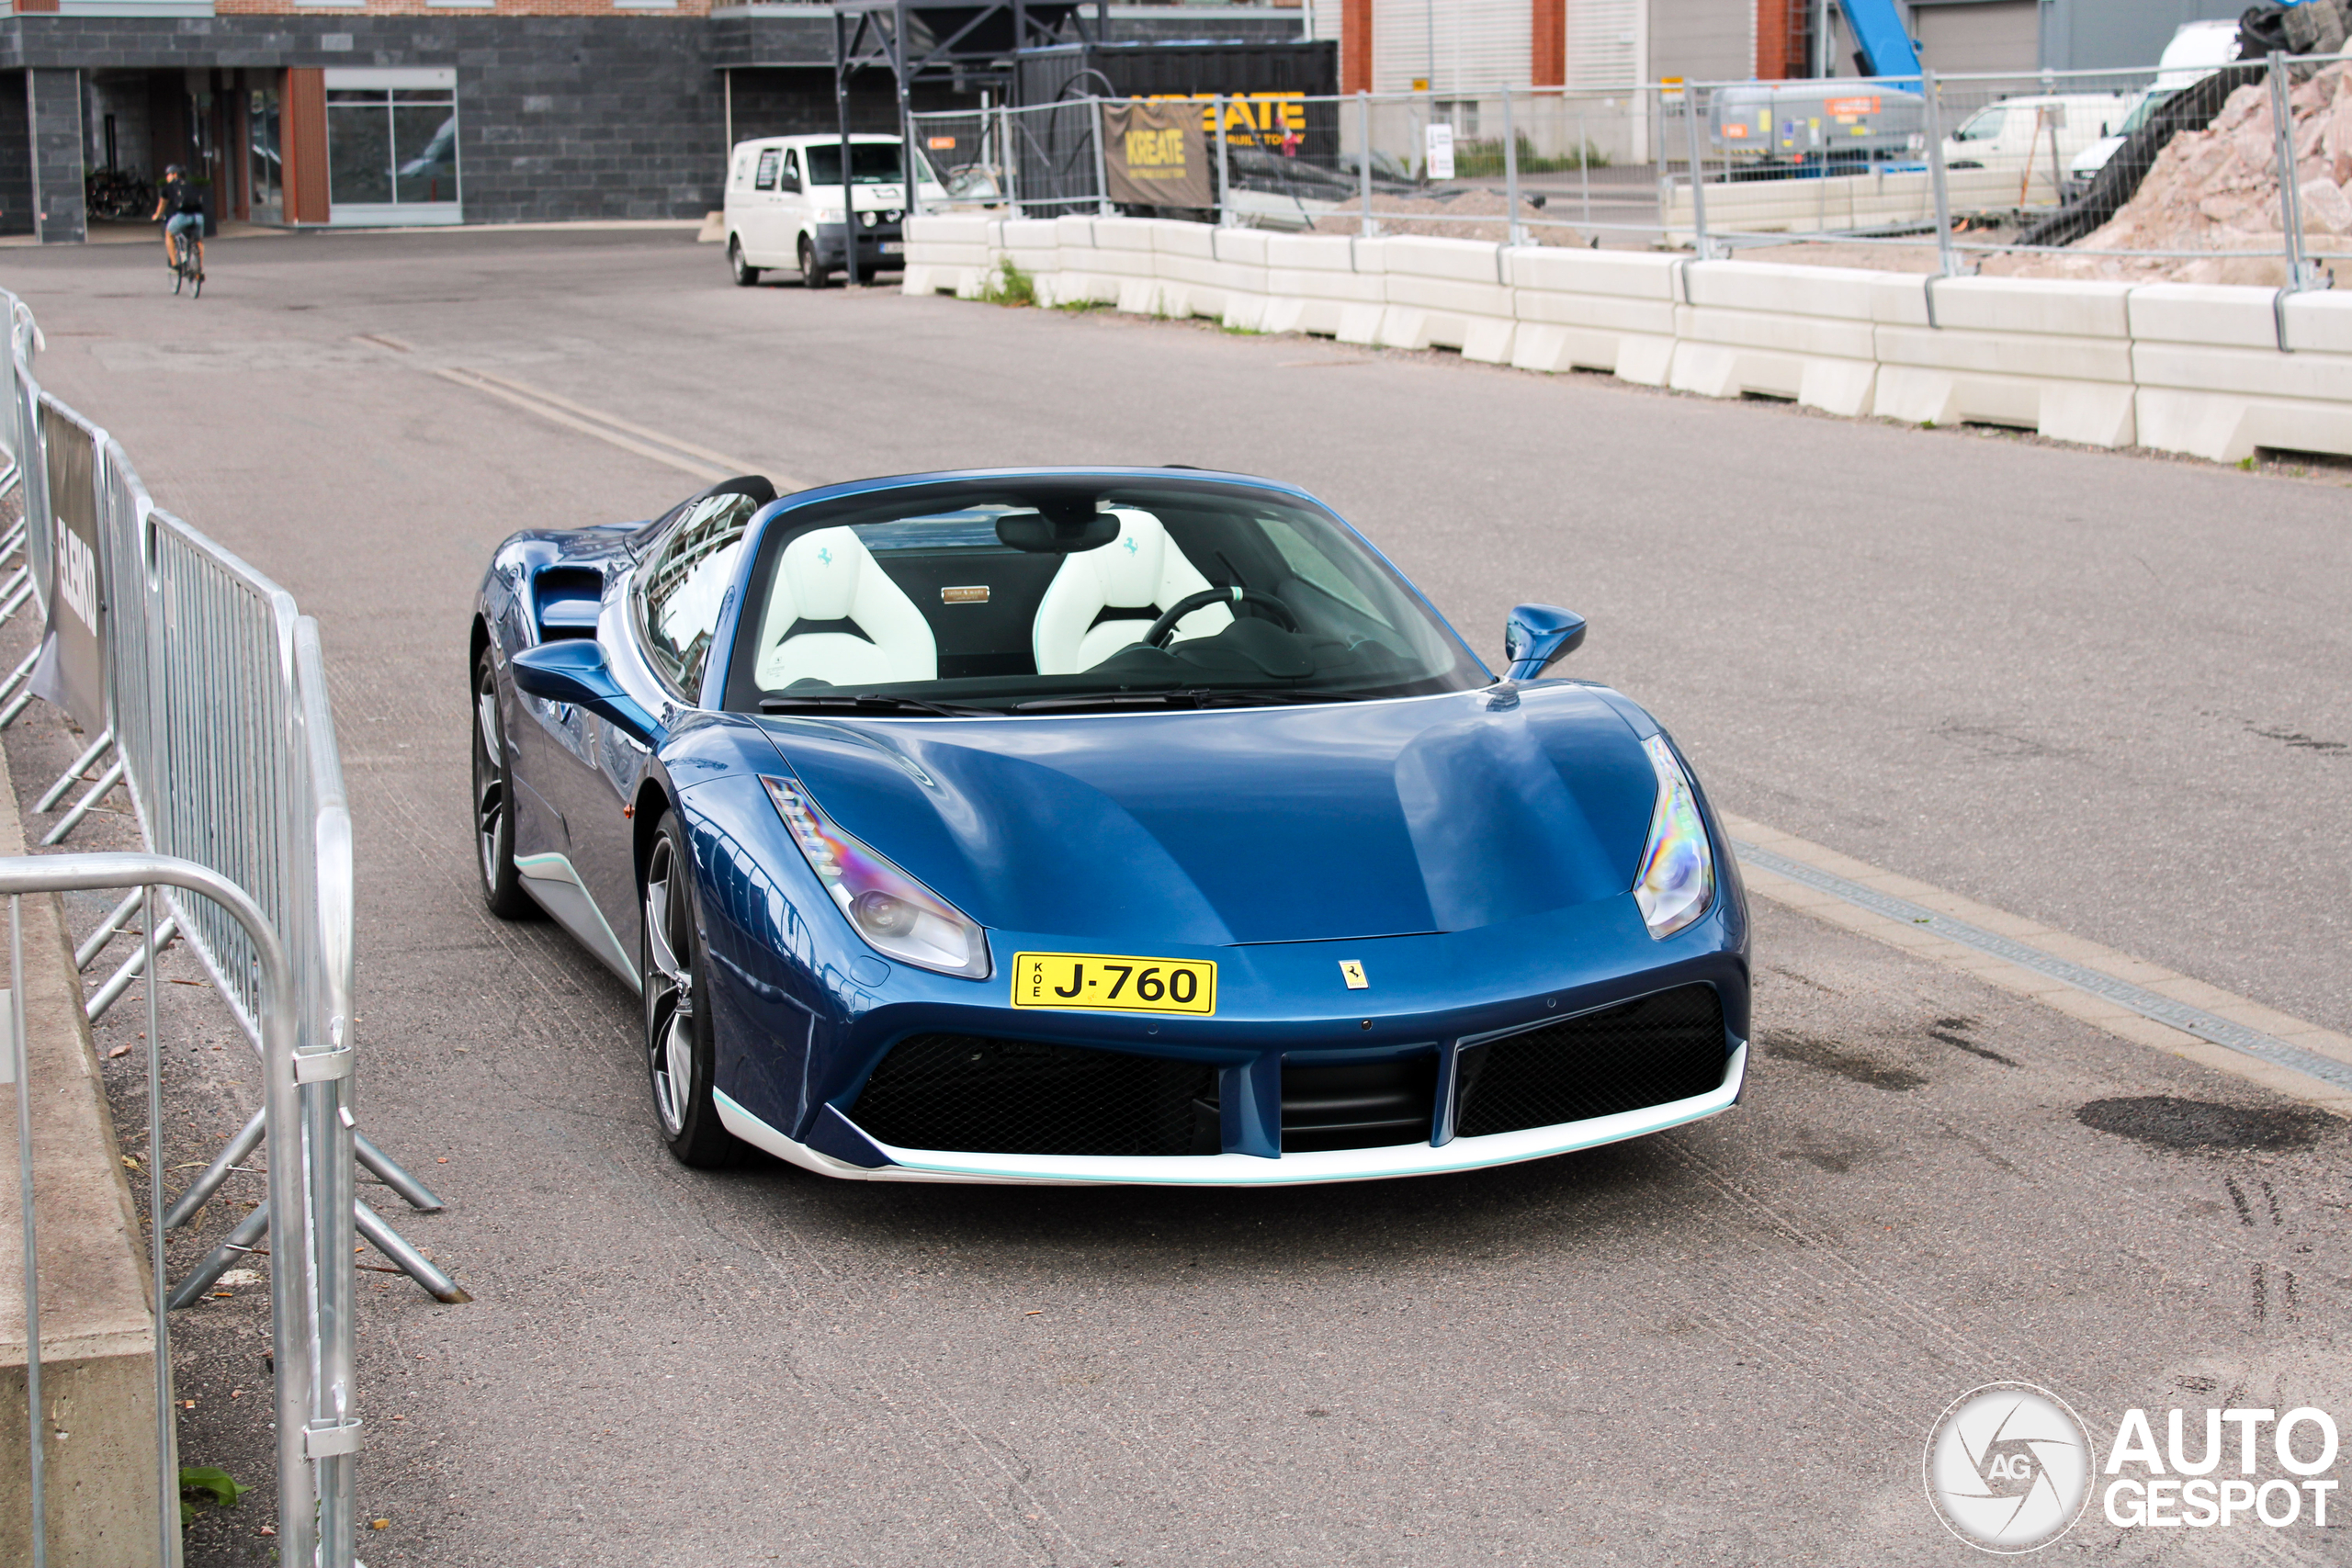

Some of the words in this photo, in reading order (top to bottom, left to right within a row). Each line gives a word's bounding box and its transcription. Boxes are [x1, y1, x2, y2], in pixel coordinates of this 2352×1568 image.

[1125, 129, 1185, 165] KREATE
[1033, 963, 1043, 997] KOE
[1054, 964, 1197, 1003] J-760
